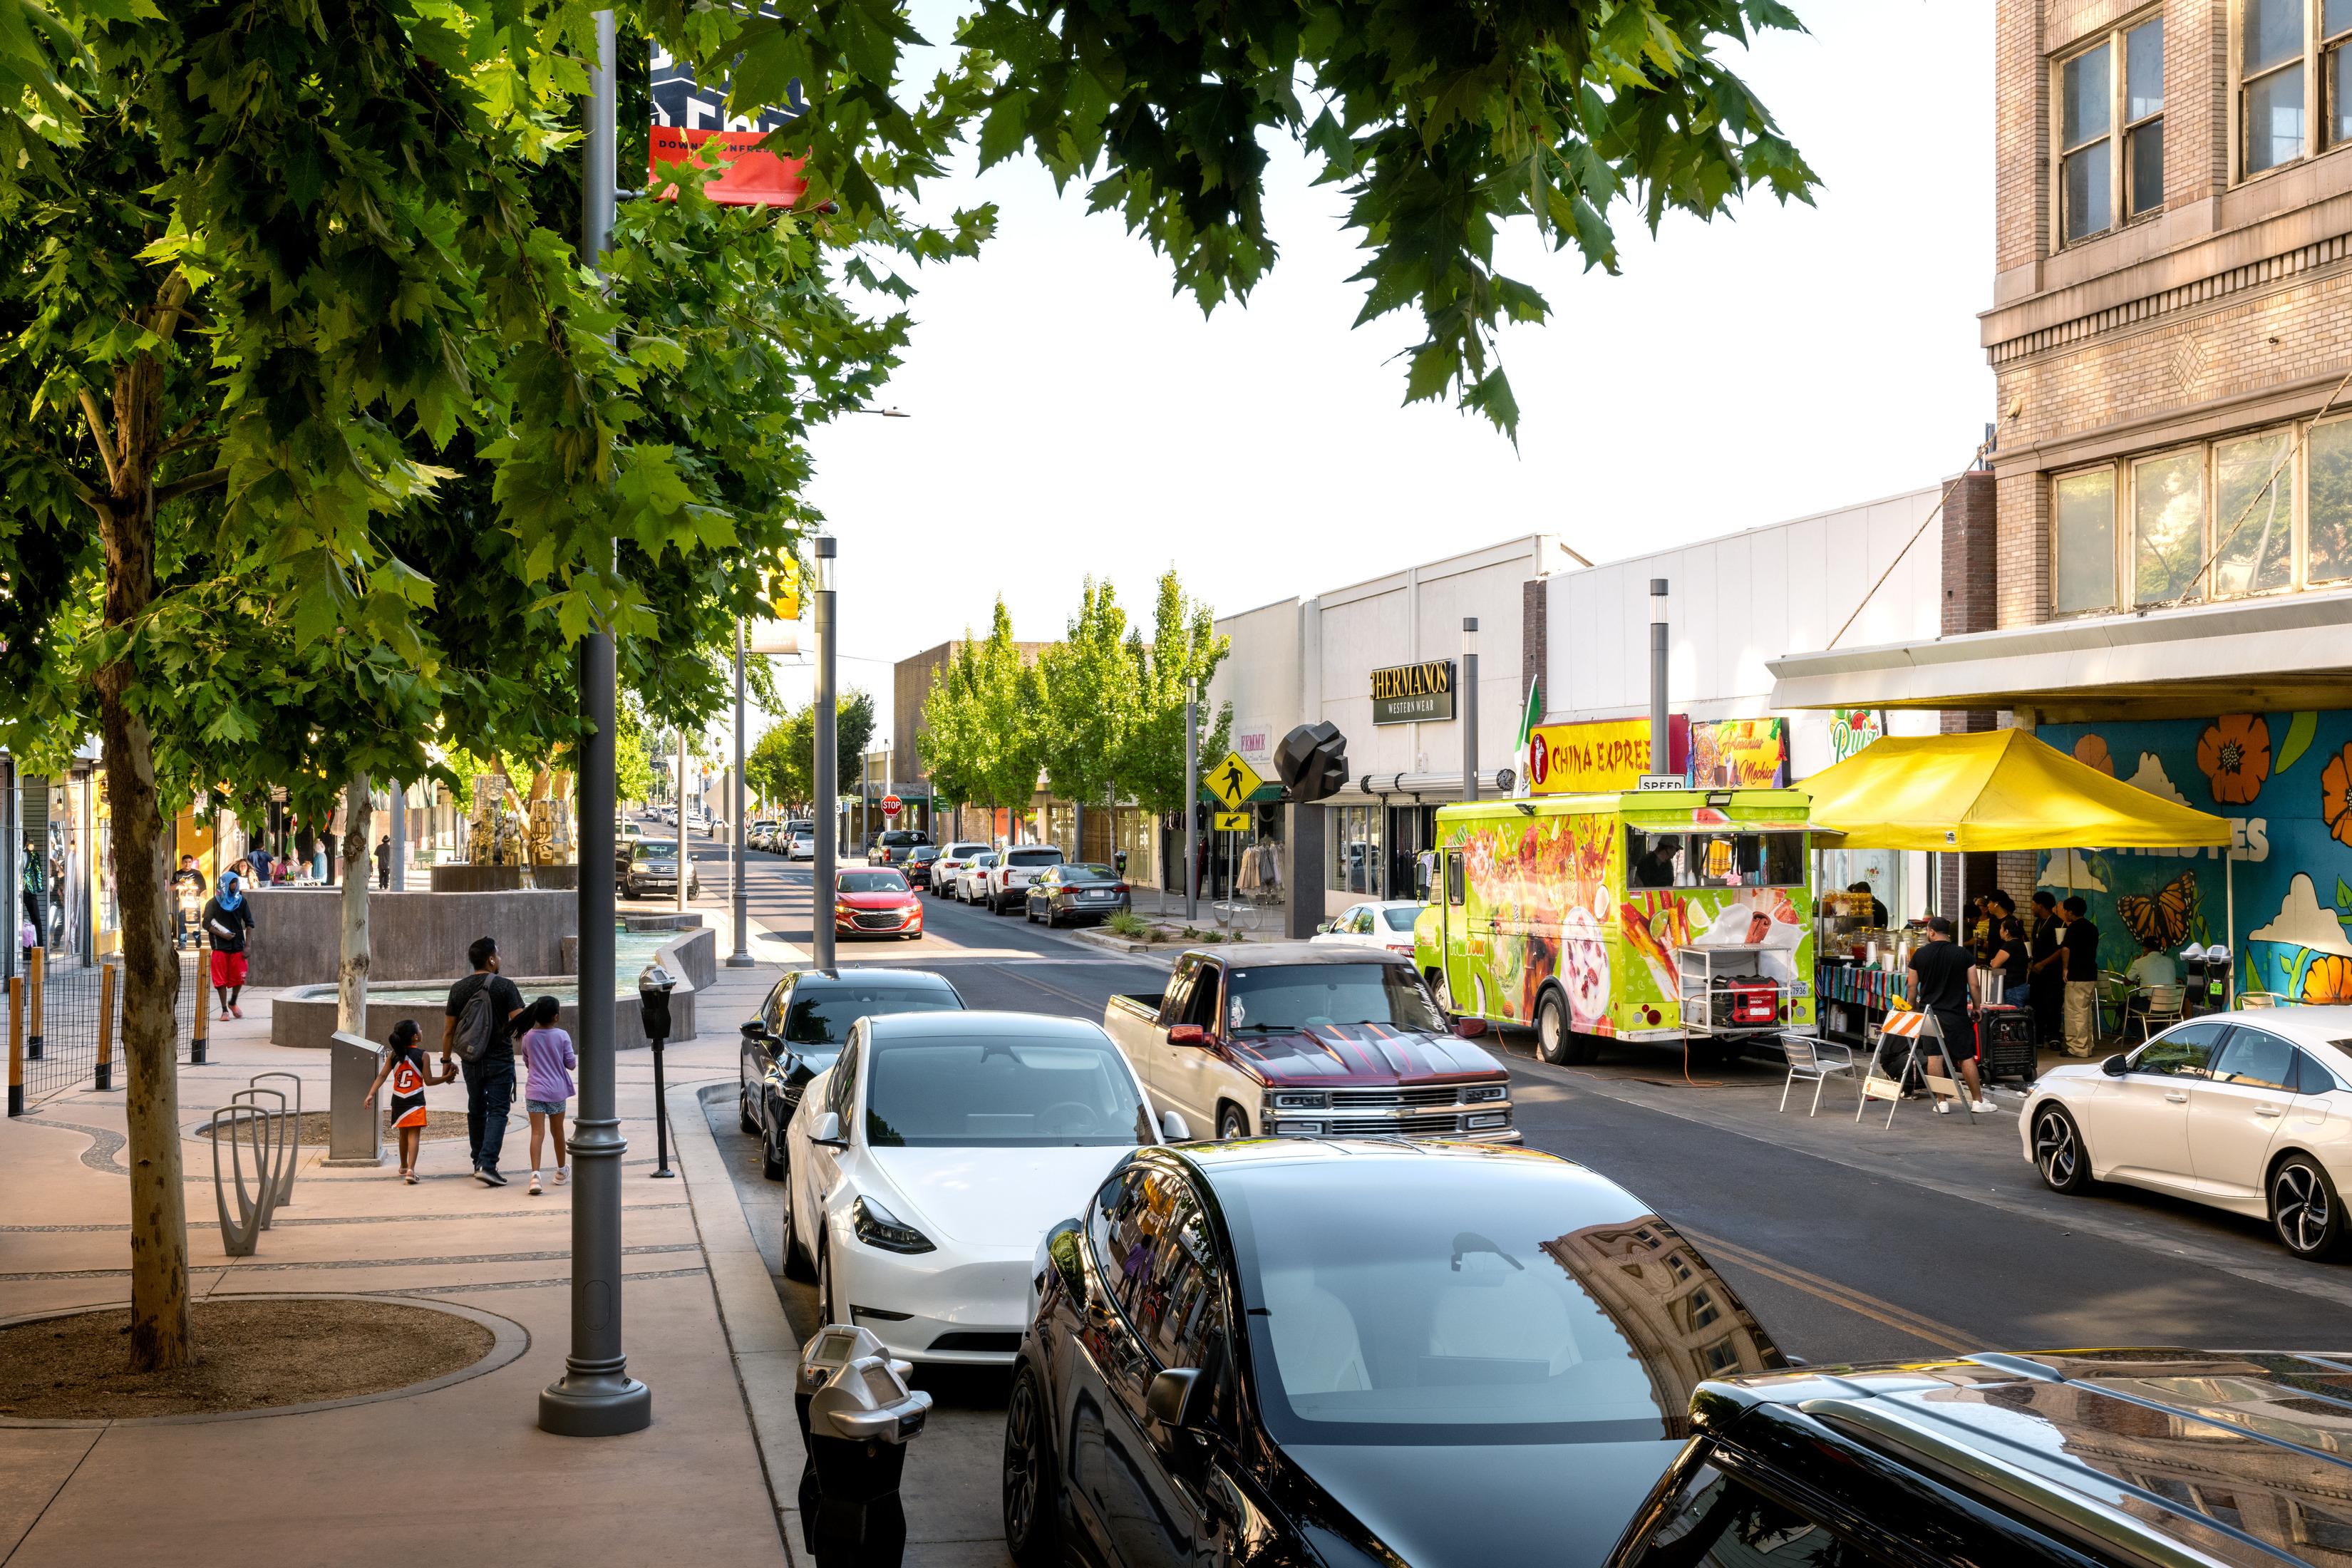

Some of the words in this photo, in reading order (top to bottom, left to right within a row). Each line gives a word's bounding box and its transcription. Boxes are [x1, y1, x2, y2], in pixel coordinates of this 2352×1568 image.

[1388, 701, 1415, 714] WESTERN
[1415, 699, 1434, 711] WEAR
[1240, 733, 1265, 752] FEMME
[1832, 721, 1877, 763] Ruiz
[1552, 741, 1592, 777] CHINA
[1597, 738, 1651, 775] EXPRES
